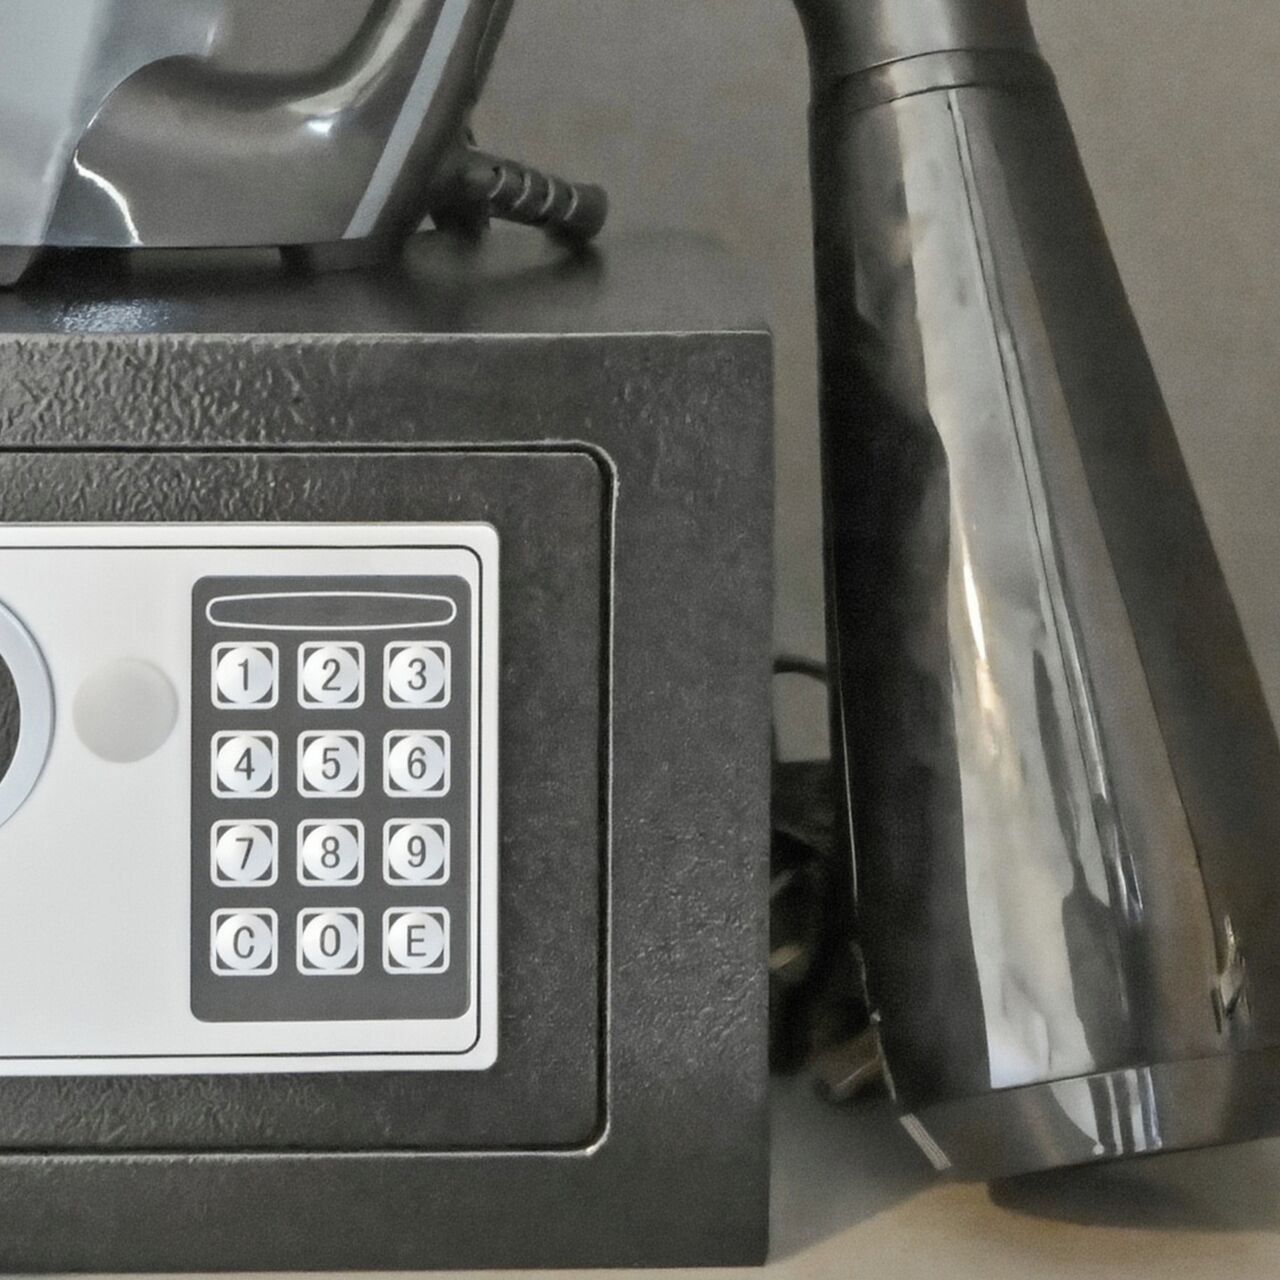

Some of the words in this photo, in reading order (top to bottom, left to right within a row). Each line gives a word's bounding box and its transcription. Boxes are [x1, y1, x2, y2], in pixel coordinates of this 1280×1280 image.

[237, 658, 249, 692] 1
[321, 658, 342, 692] 2
[407, 657, 427, 691] 3
[234, 747, 256, 781] 4
[321, 747, 341, 780] 5
[407, 746, 427, 780] 6
[235, 837, 254, 871] 7
[320, 836, 341, 869] 8
[407, 835, 427, 868] 9
[233, 925, 255, 959] C
[406, 924, 427, 957] E
